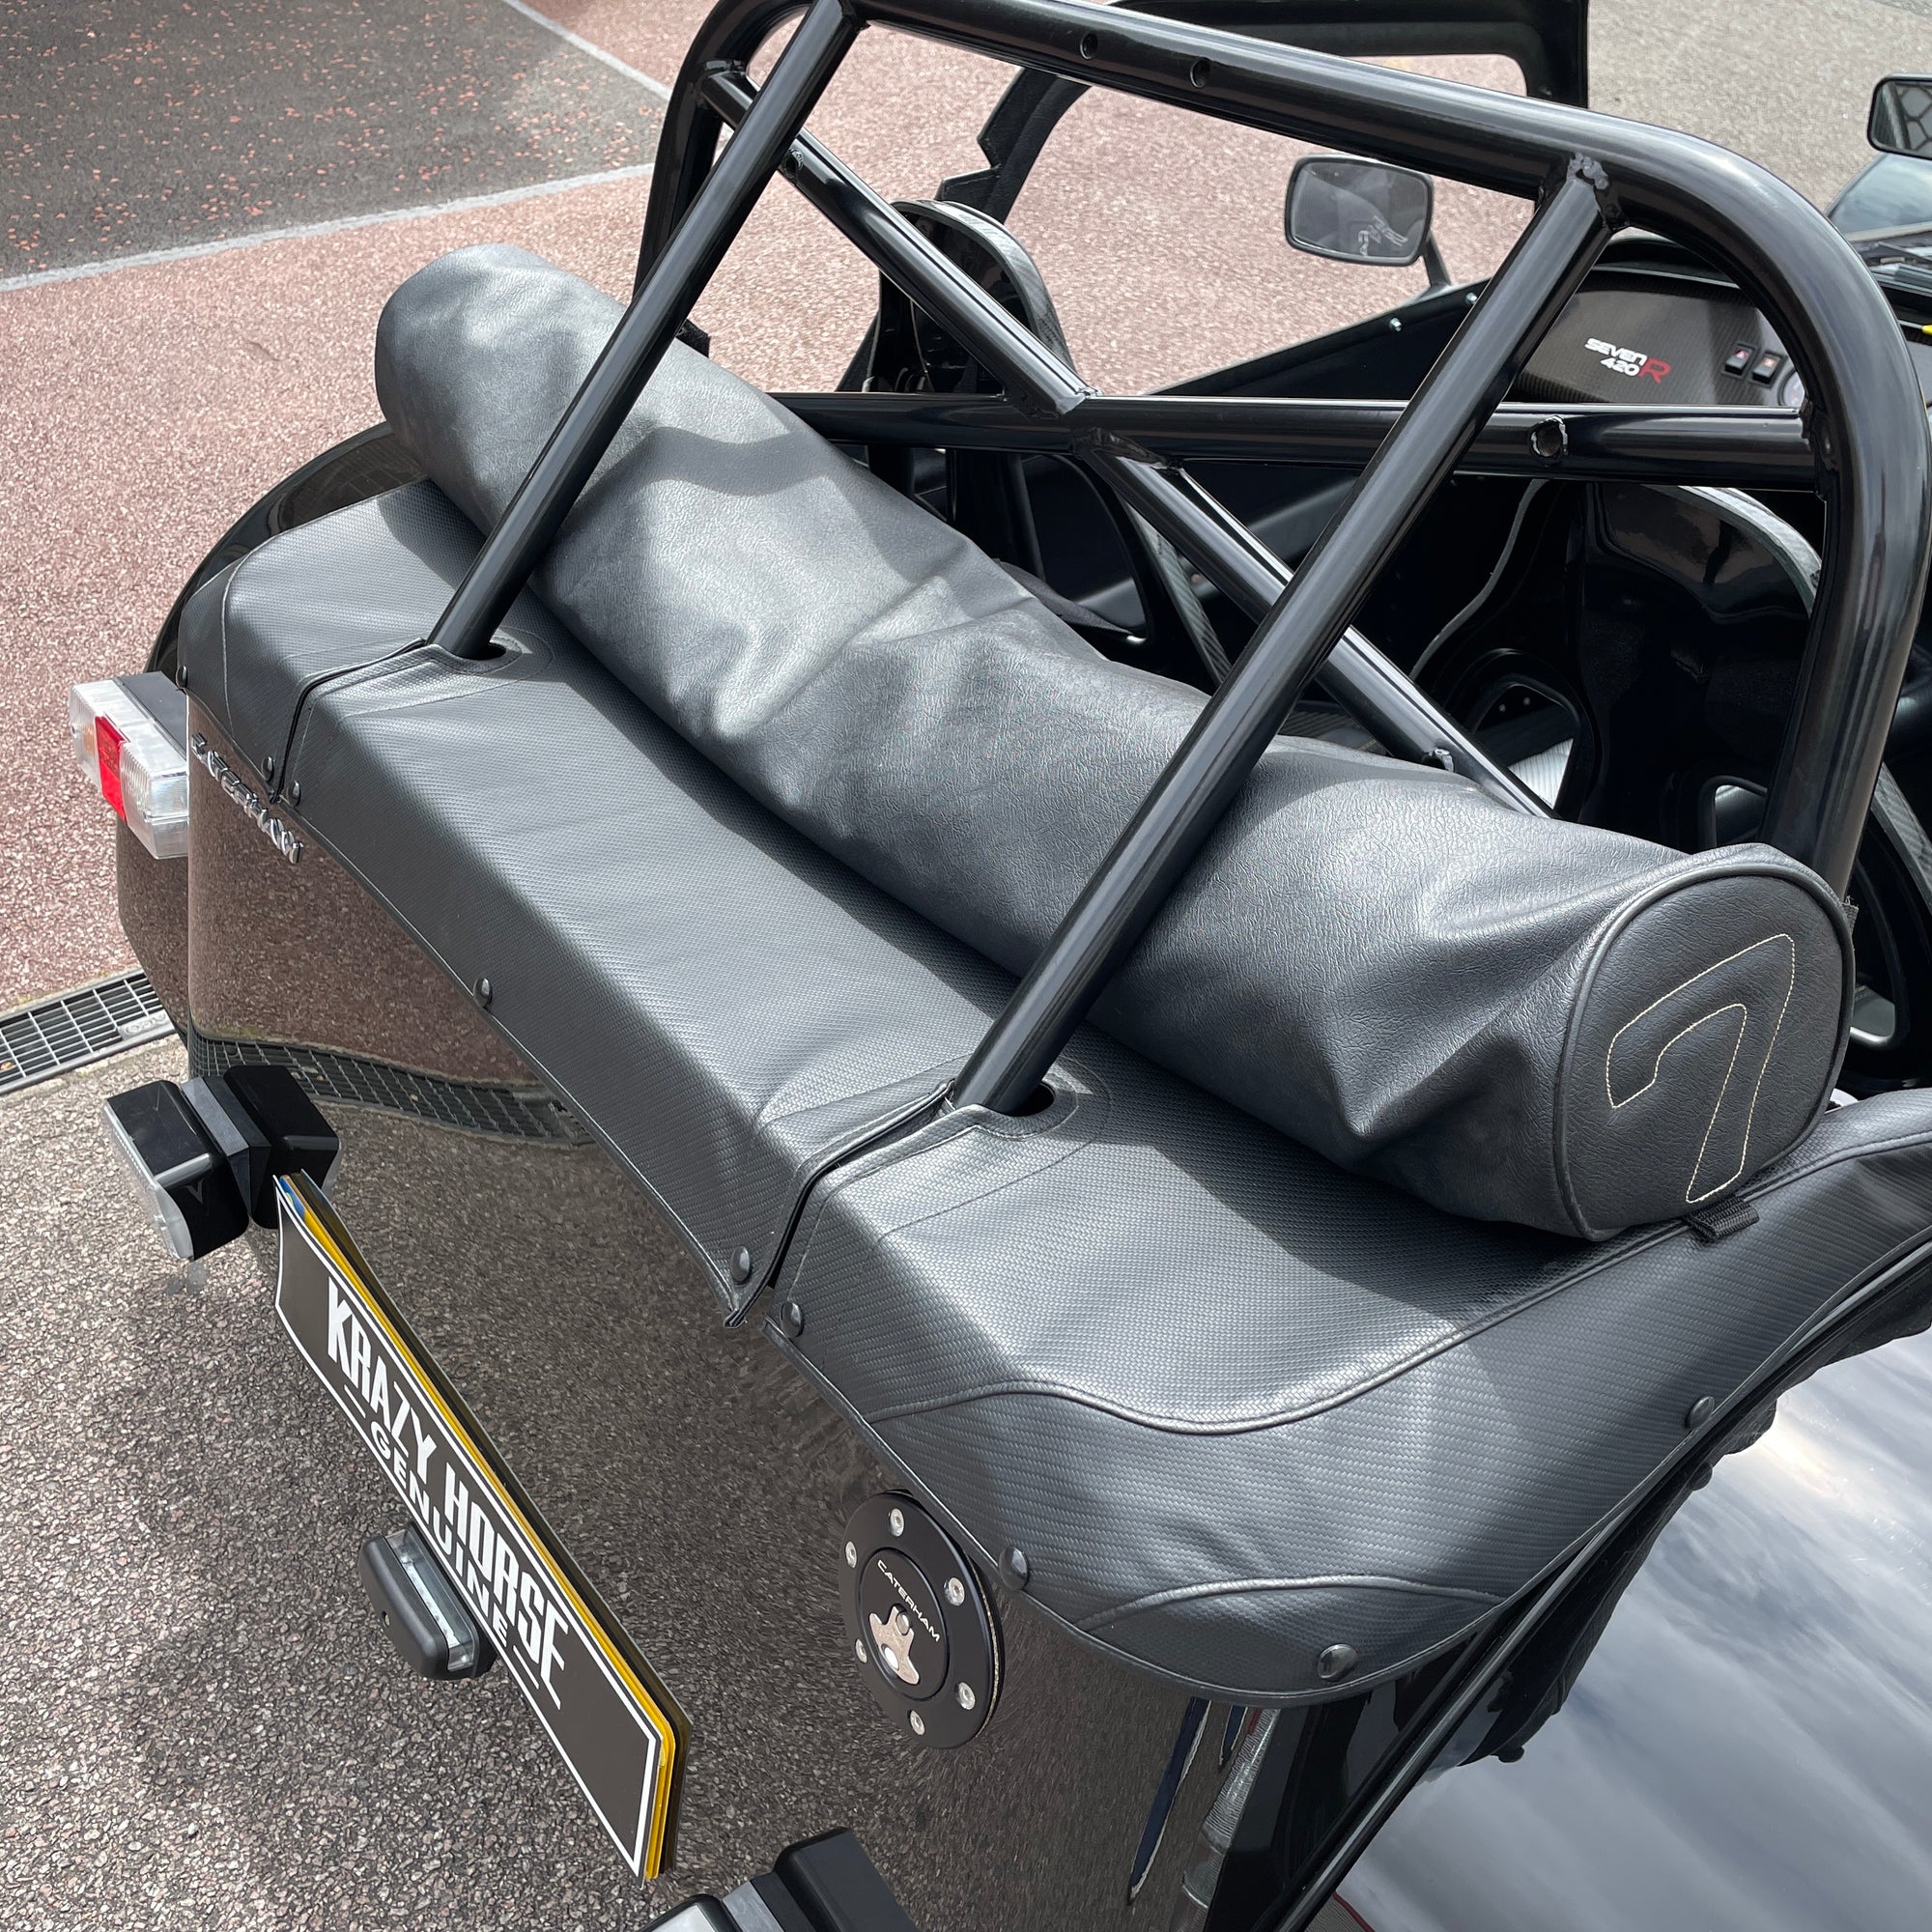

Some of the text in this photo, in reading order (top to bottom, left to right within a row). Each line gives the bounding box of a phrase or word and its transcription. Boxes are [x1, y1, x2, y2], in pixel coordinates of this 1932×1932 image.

[327, 1276, 570, 1710] KRAZY HORSE
[370, 1422, 509, 1648] GENUINE
[877, 1559, 941, 1642] CATERHAM
